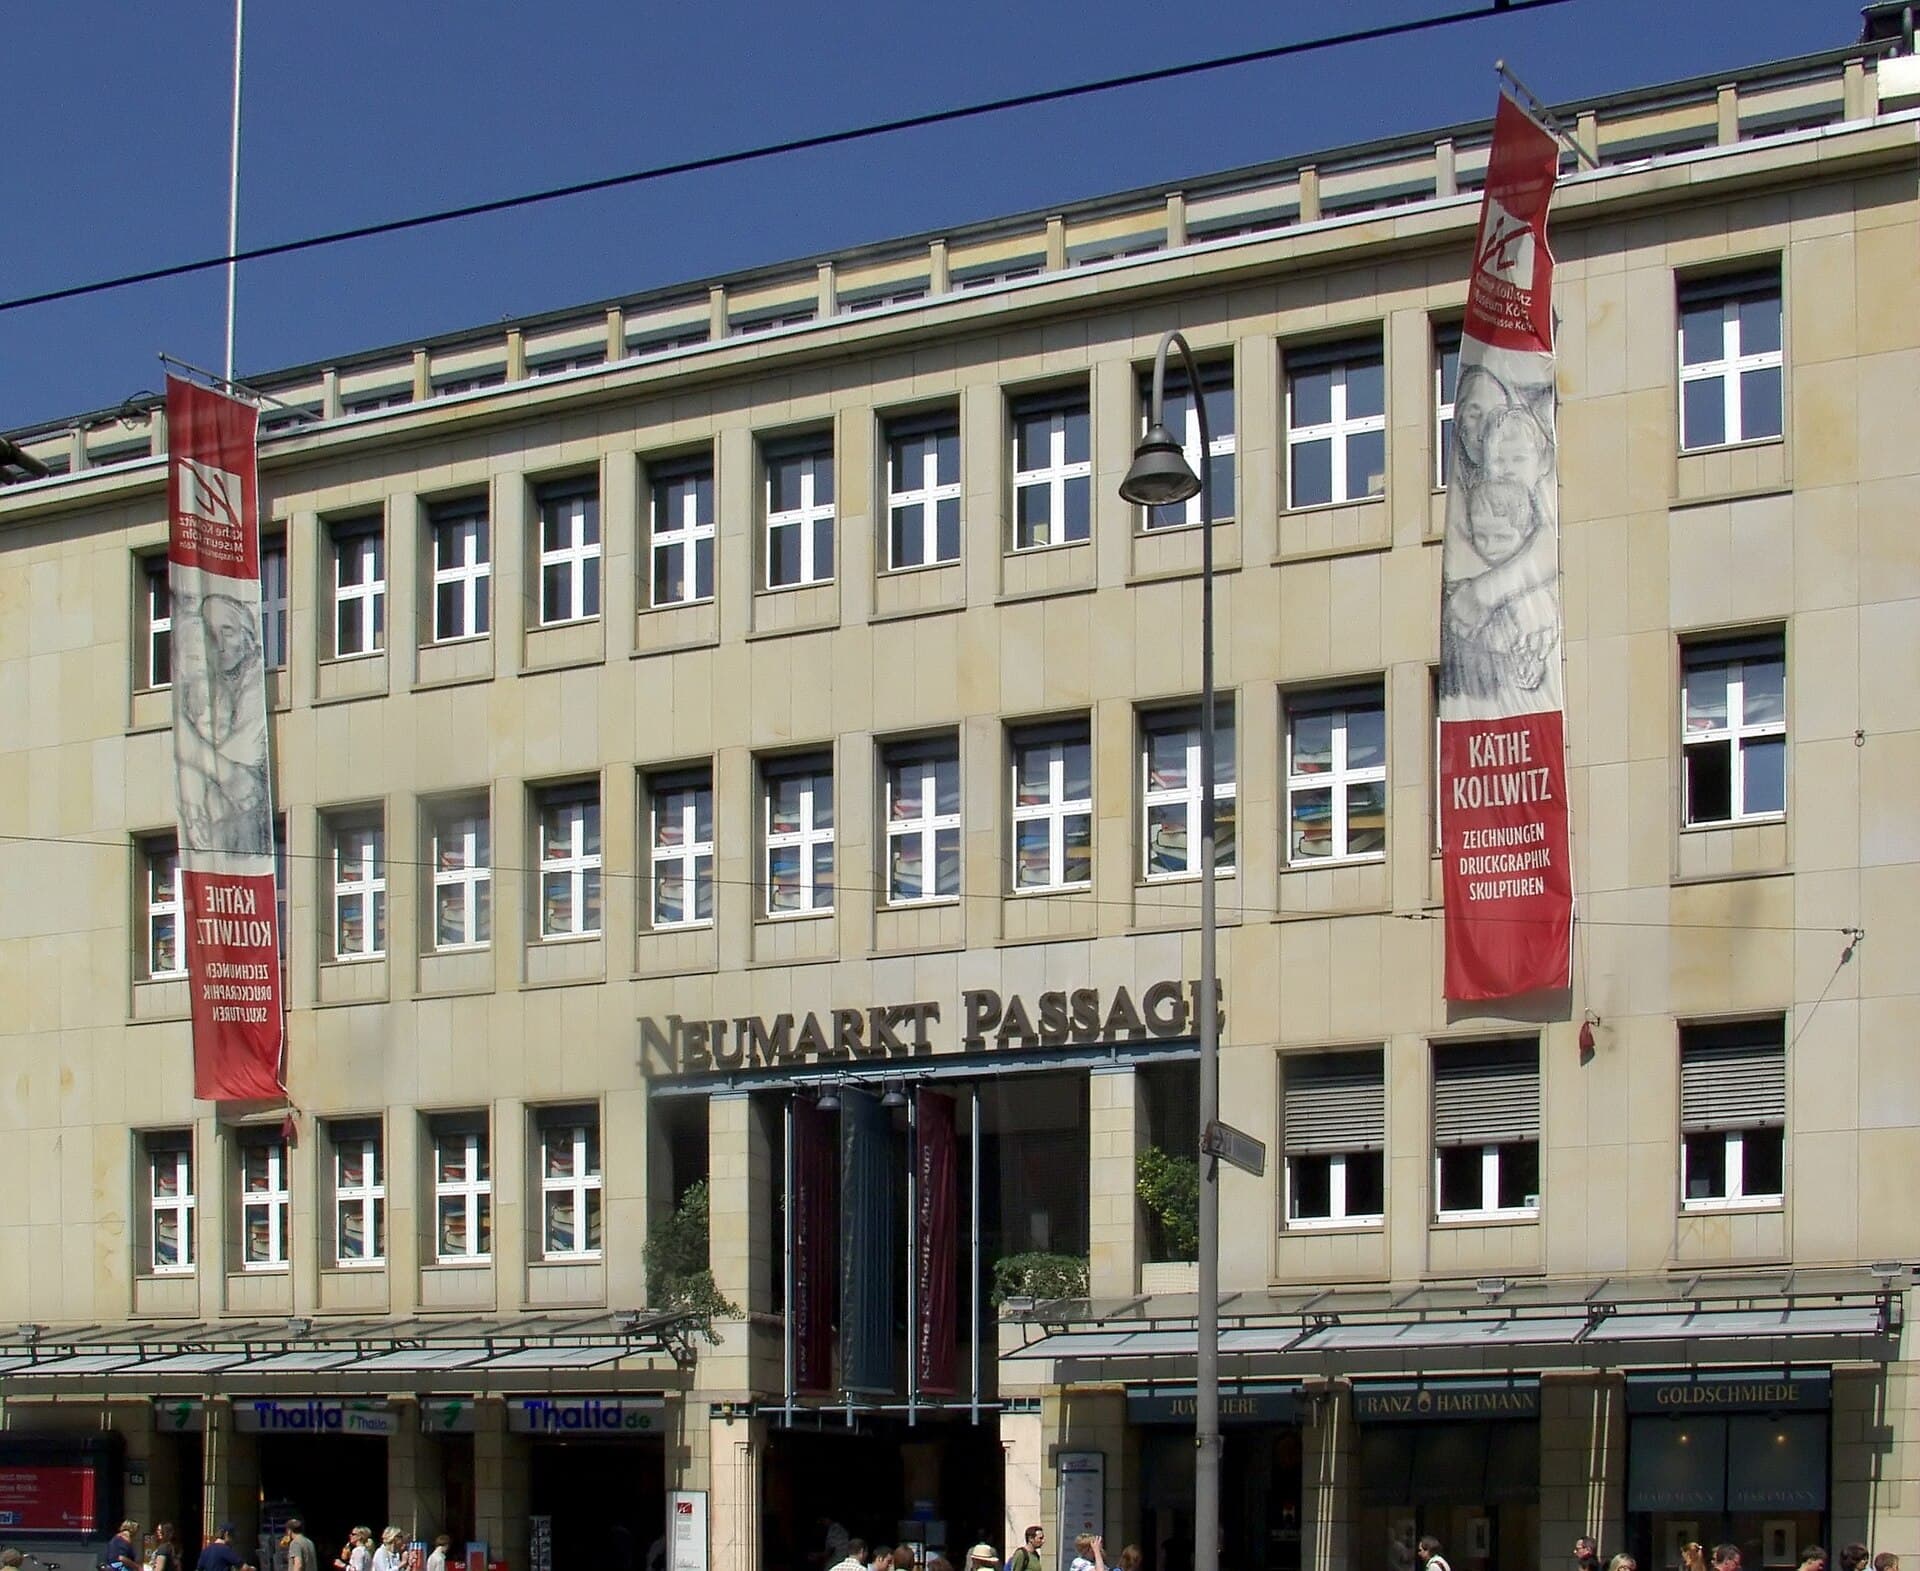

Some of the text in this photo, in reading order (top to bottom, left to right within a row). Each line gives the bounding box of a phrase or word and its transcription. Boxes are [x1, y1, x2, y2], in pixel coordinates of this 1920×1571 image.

[1468, 730, 1532, 768] KÄTHE
[1453, 767, 1552, 810] KOLLWITZ
[1462, 822, 1545, 849] ZEICHNUNGEN
[1459, 848, 1551, 875] DRUCKGRAPHIK
[1469, 876, 1544, 901] SKULPTUREN
[637, 978, 1224, 1075] NEUMARKT PASSAGE
[1357, 1393, 1534, 1413] FRANZ HARTMANN
[1656, 1384, 1800, 1404] GOLDSCHMIEDE
[255, 1401, 343, 1429] Thalia
